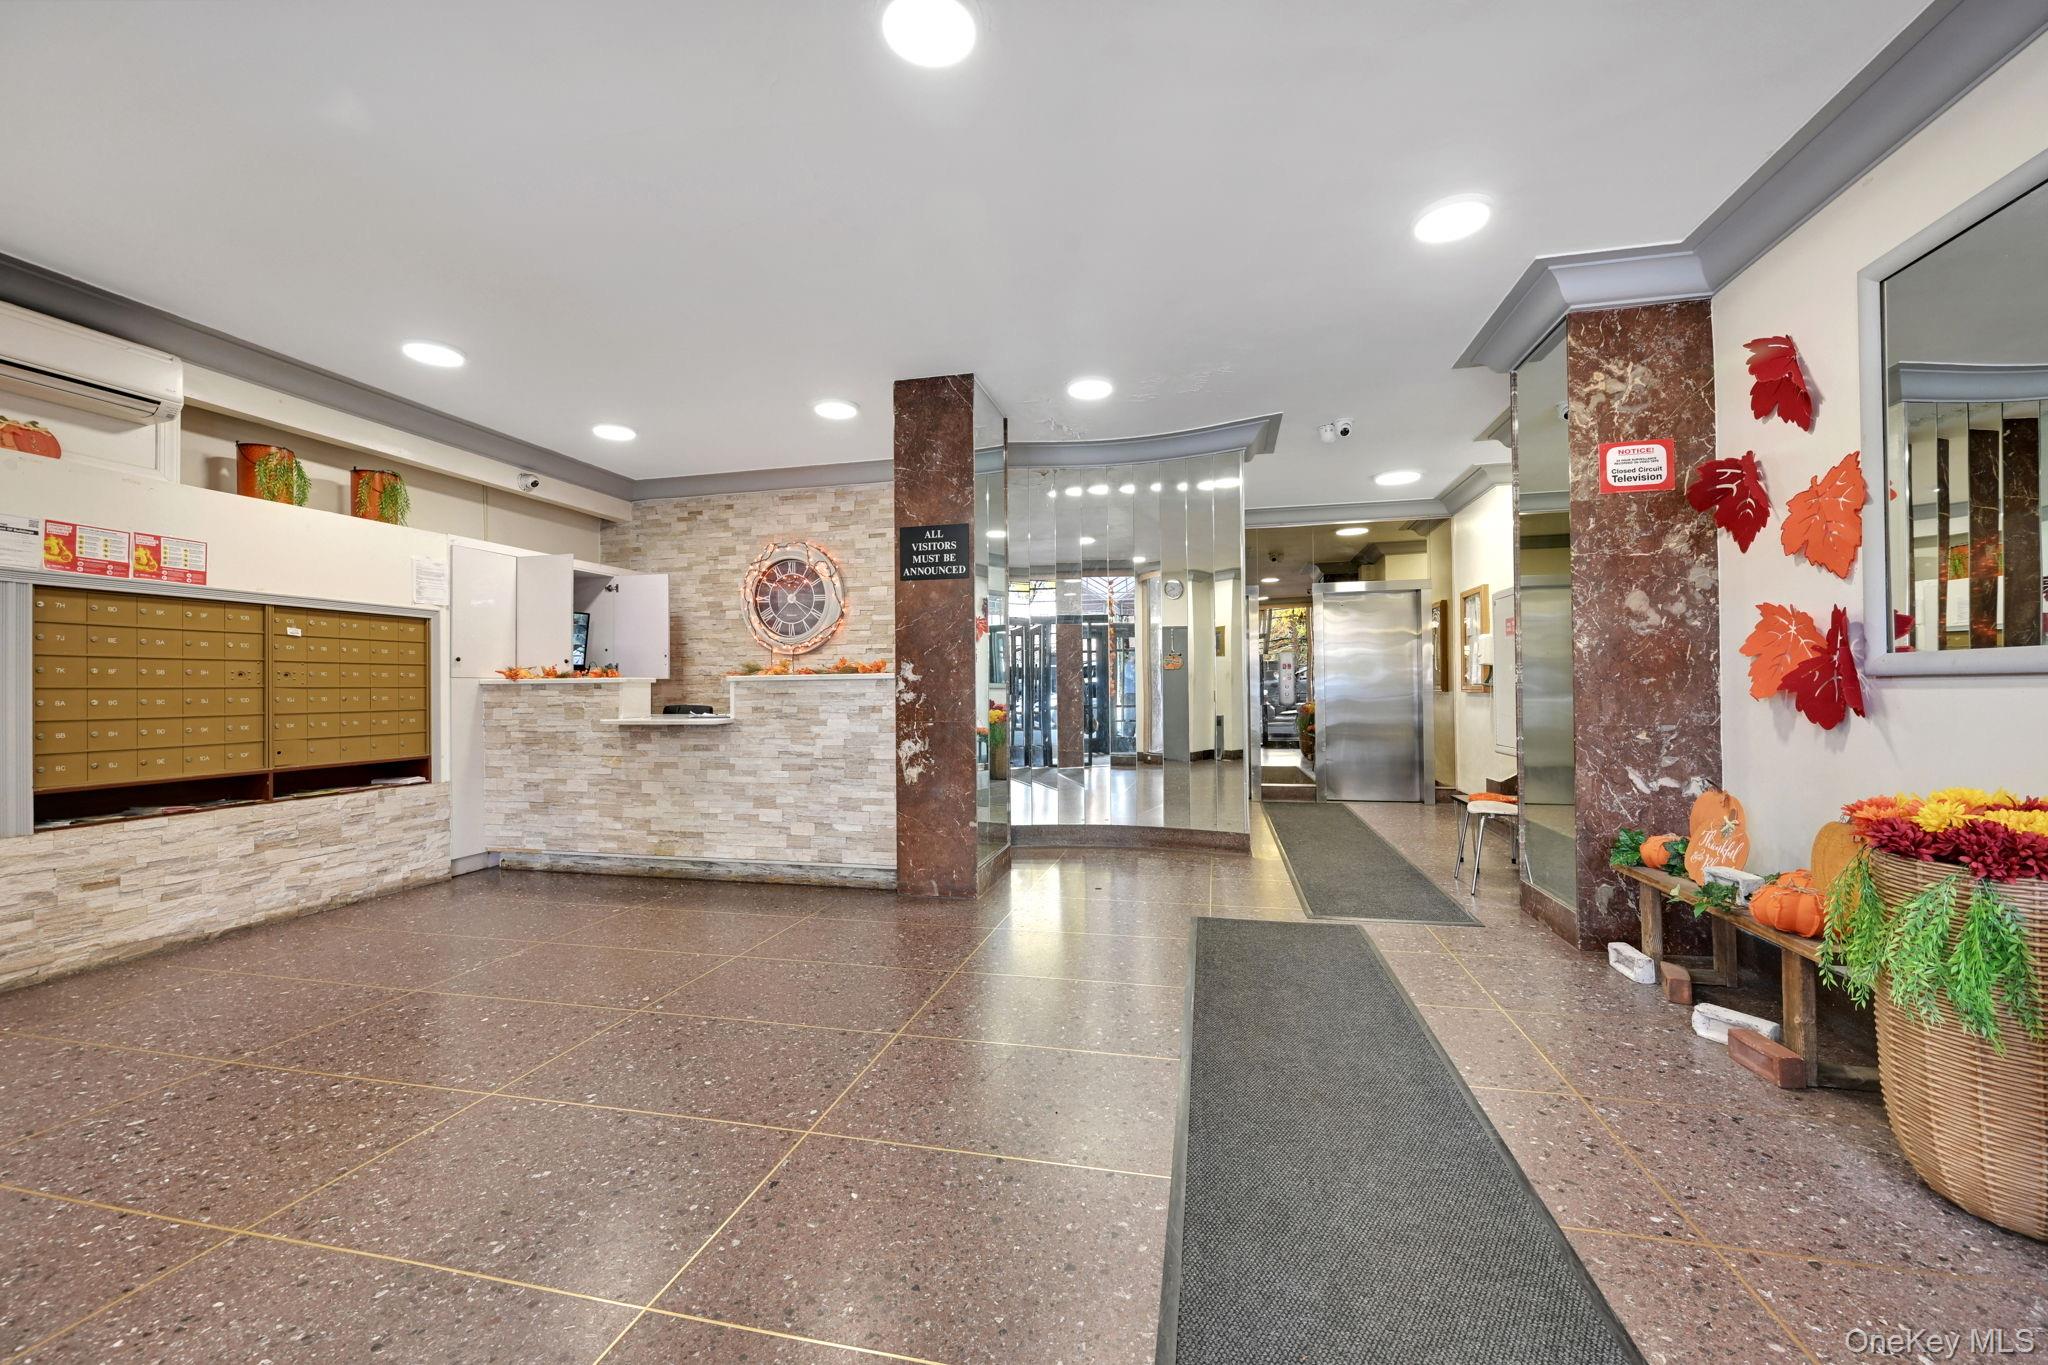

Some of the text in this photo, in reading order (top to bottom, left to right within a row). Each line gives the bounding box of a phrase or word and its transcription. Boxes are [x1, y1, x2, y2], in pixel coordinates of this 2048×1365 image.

[1612, 472, 1662, 483] Television
[924, 530, 944, 539] ALL
[912, 541, 957, 551] VISITORS
[912, 554, 956, 564] MUST BE
[903, 566, 966, 576] ANNOUNCED
[1698, 827, 1745, 864] Thankful
